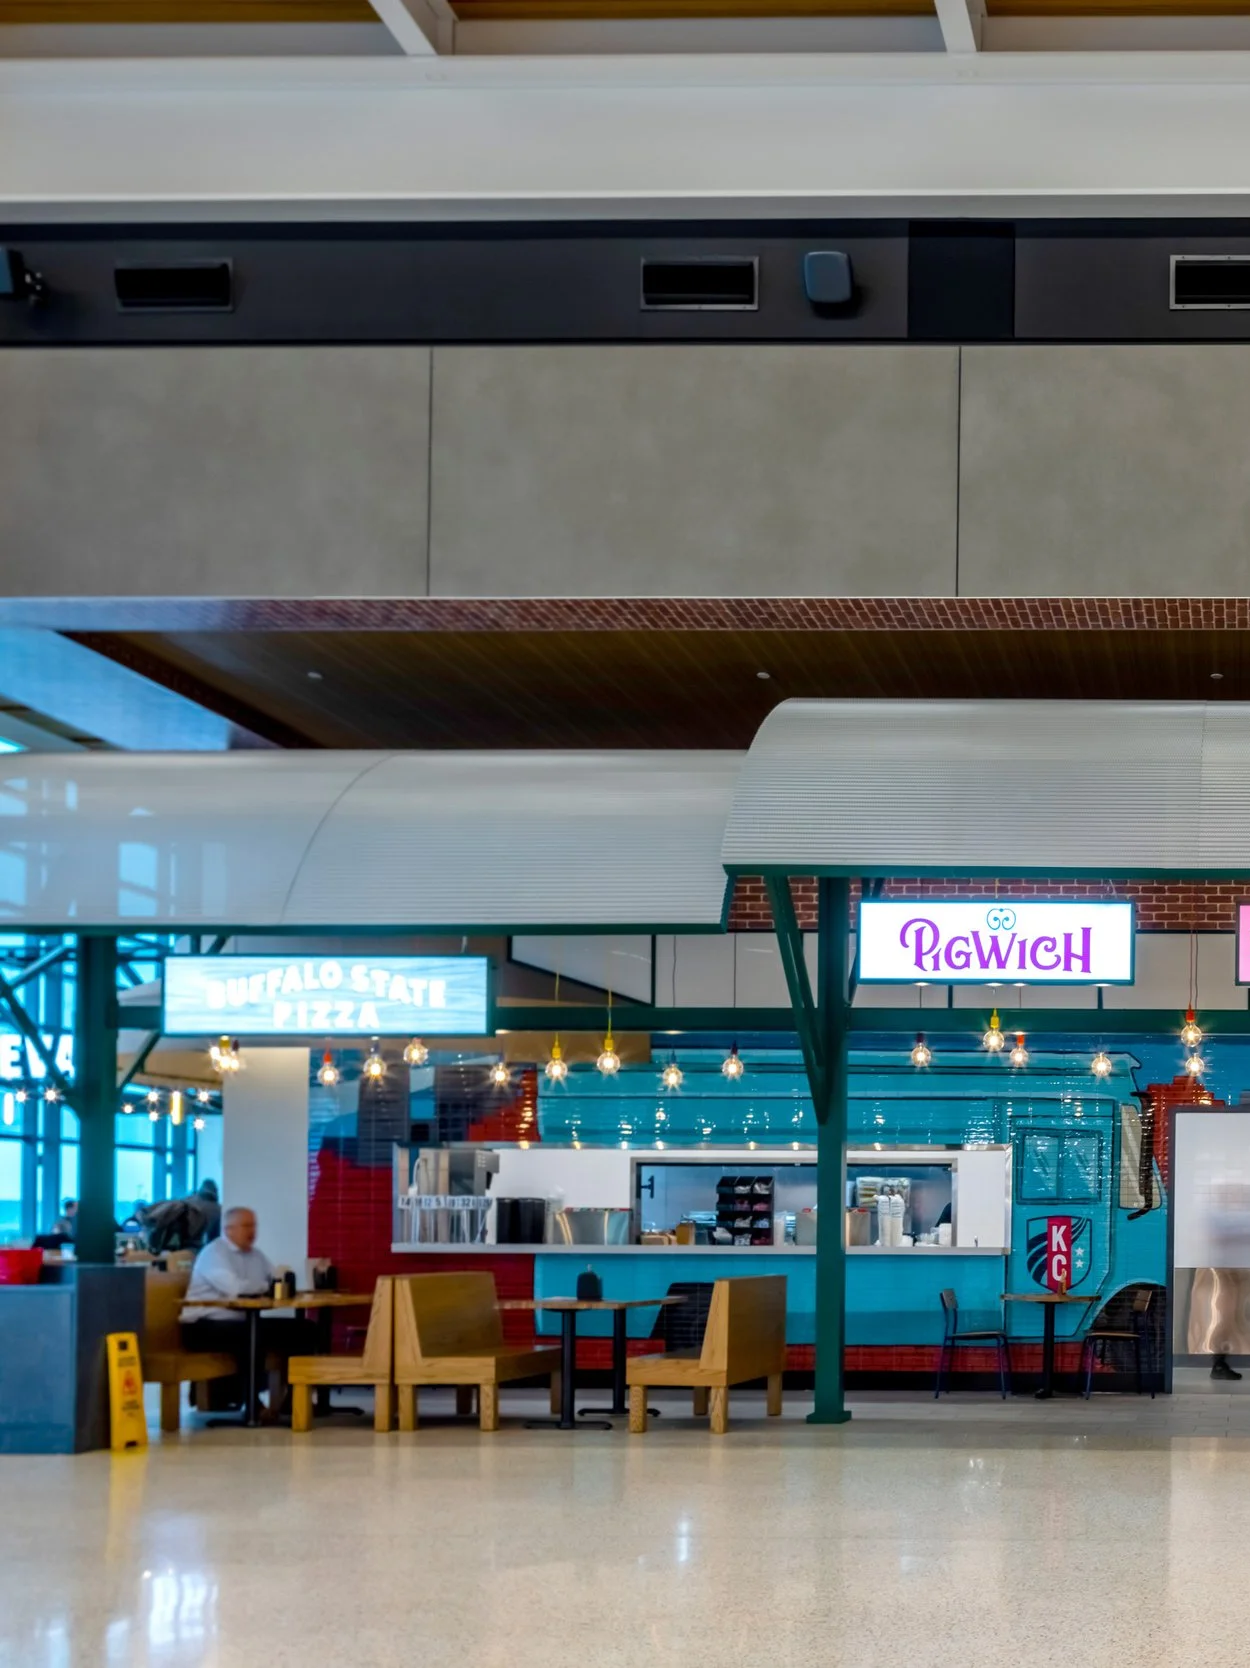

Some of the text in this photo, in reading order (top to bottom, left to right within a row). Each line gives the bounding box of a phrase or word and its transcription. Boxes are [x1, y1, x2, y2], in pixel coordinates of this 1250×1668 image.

[205, 960, 447, 1009] BUFFALO STATE
[272, 1001, 380, 1029] PIZZA
